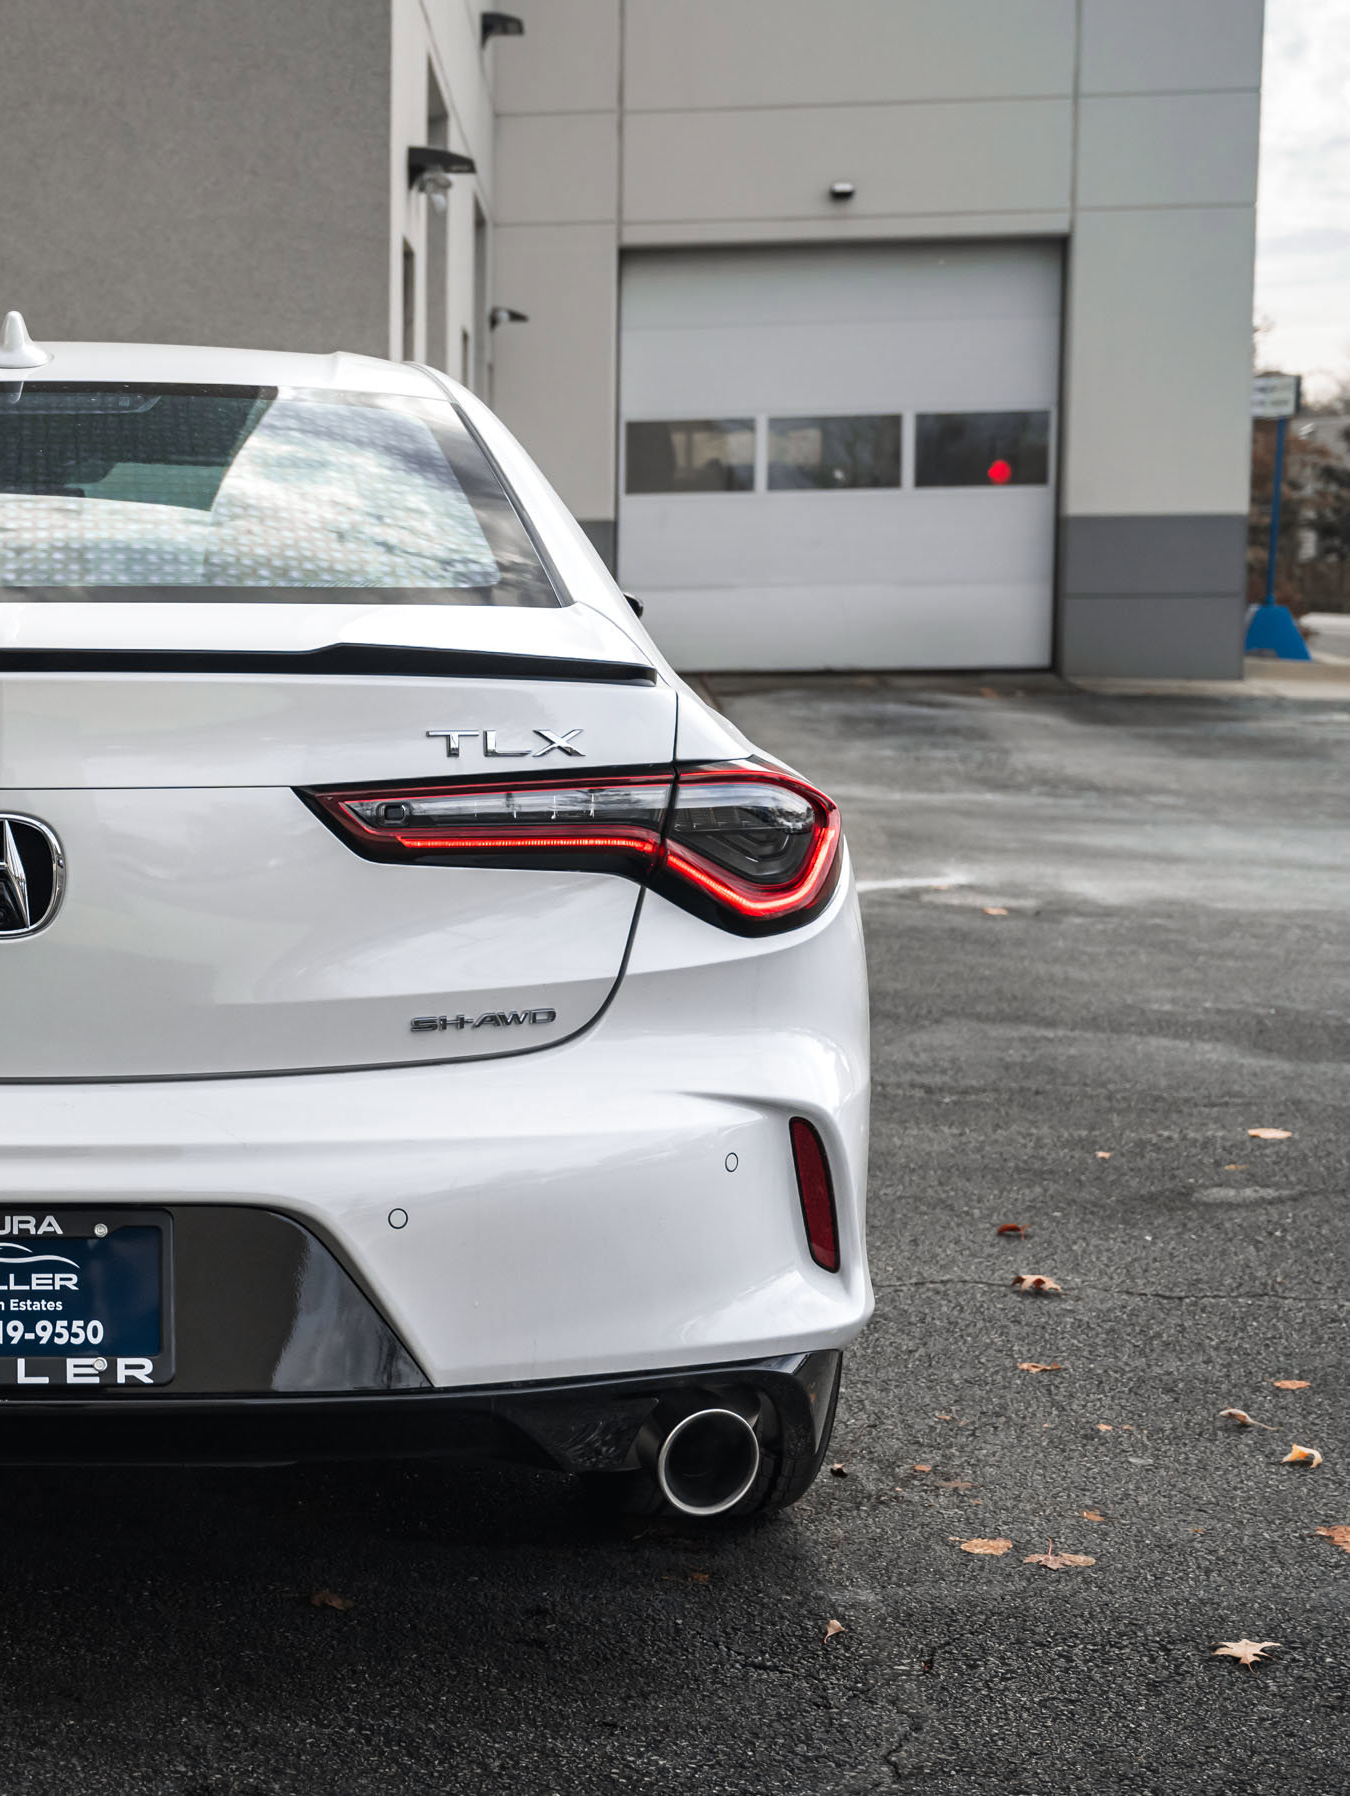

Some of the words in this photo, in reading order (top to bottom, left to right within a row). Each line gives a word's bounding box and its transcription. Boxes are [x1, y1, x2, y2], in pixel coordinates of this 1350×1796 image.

[426, 729, 585, 757] TLX
[410, 1008, 557, 1032] SH-AWD
[9, 1299, 63, 1311] Estates
